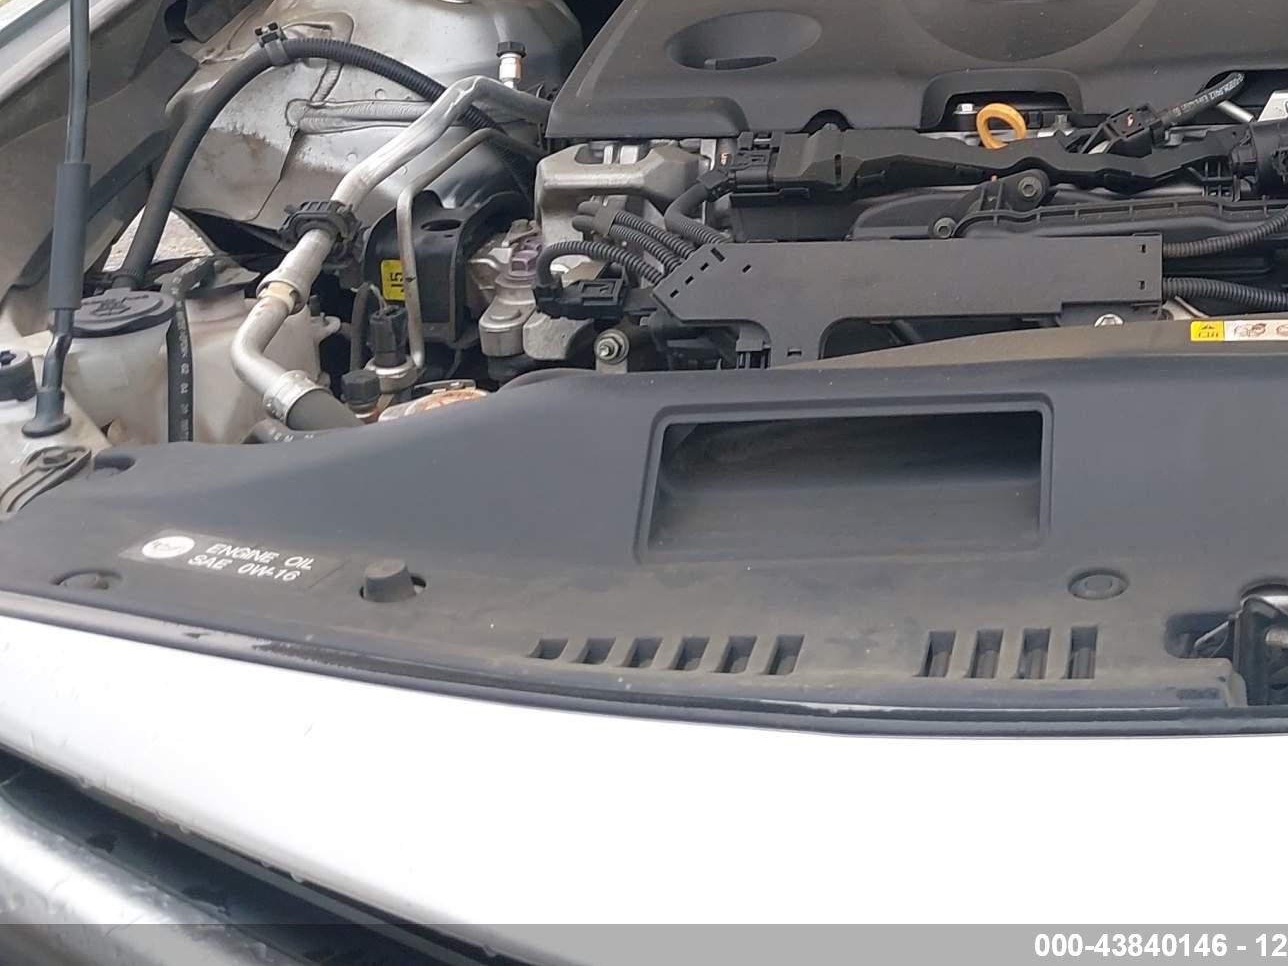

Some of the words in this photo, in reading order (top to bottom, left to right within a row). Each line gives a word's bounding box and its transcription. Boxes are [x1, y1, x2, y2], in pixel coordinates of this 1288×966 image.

[187, 555, 233, 570] SAE
[238, 563, 301, 581] 0W-16
[206, 543, 279, 564] ENGINE
[284, 556, 314, 570] OIL
